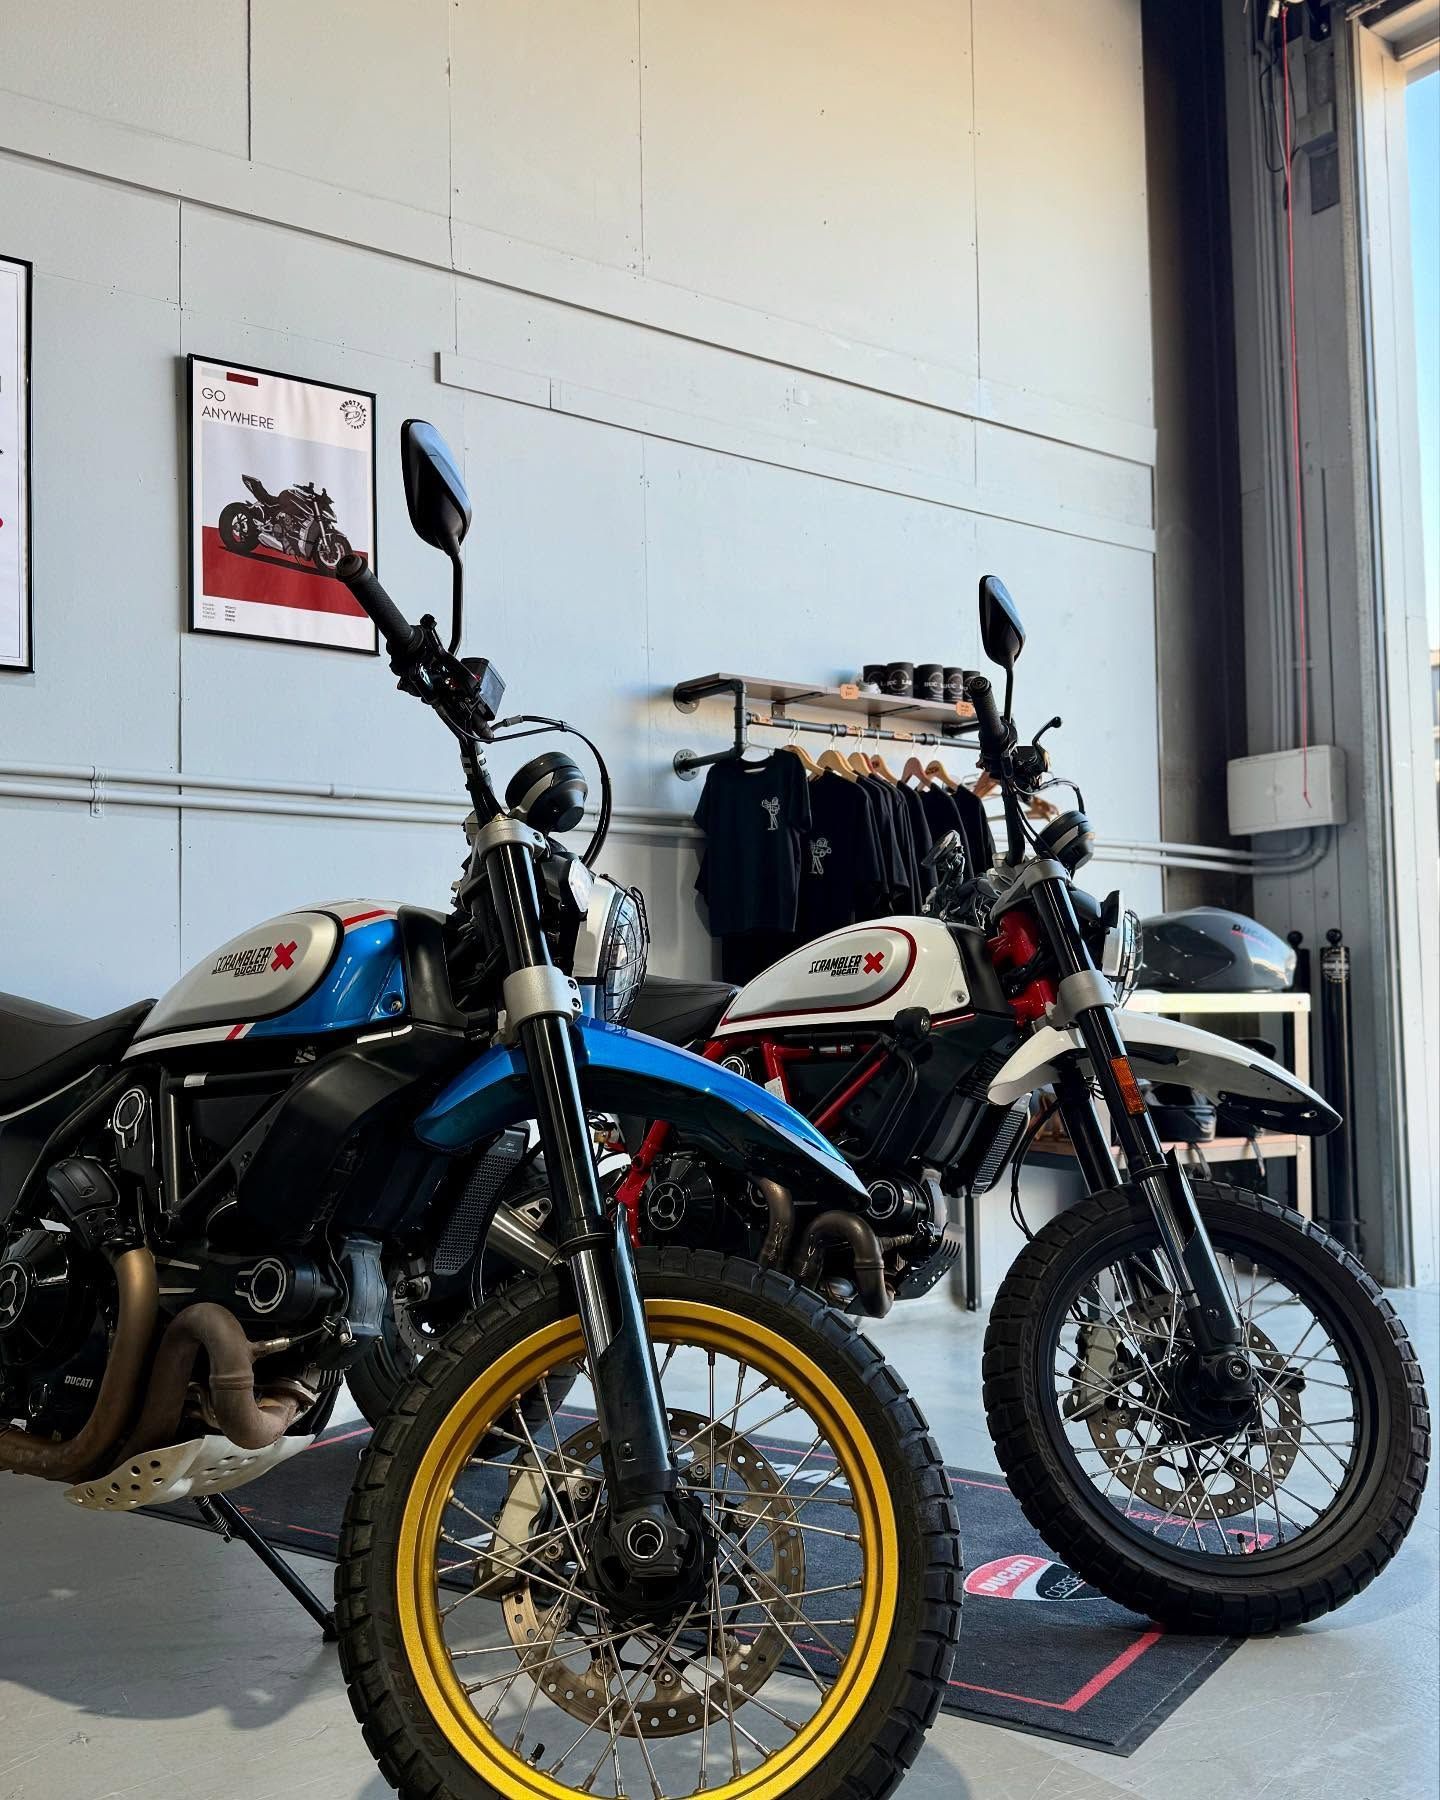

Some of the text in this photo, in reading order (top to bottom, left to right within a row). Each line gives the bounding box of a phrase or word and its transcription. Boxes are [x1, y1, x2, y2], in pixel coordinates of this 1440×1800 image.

[202, 387, 226, 402] GO
[202, 405, 274, 429] ANYWHERE
[212, 946, 273, 975] SCRAMBLER
[808, 955, 862, 974] SCRAMBLER
[233, 964, 266, 977] DUCATI
[830, 968, 859, 976] DUCATI
[64, 1375, 94, 1388] DUCATI
[977, 1560, 1036, 1592] DUCATI
